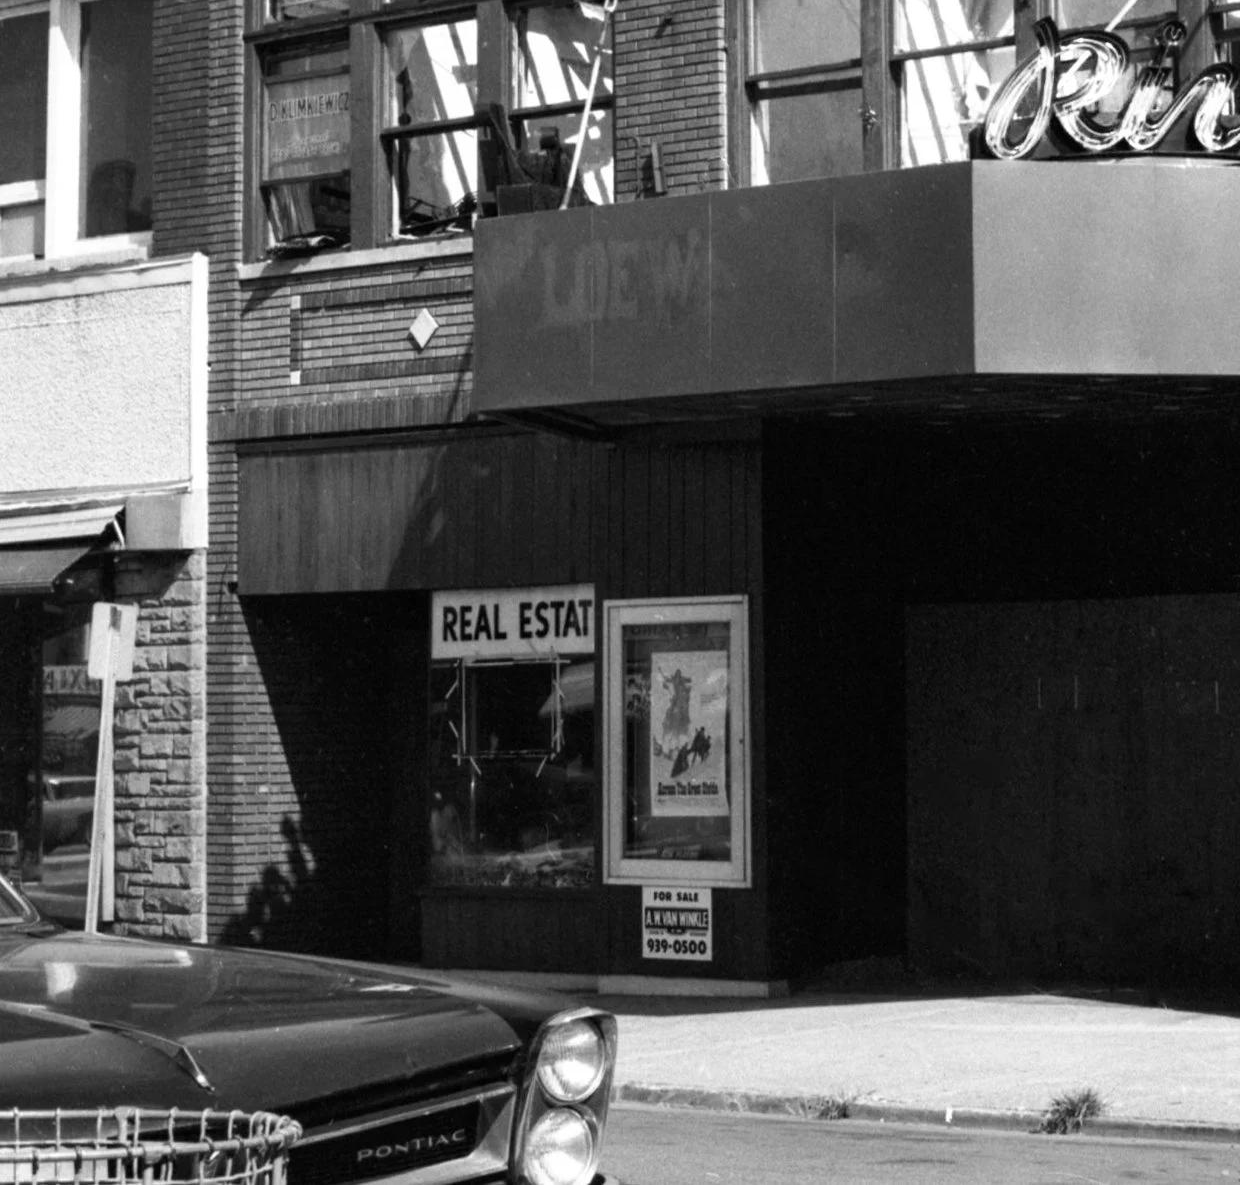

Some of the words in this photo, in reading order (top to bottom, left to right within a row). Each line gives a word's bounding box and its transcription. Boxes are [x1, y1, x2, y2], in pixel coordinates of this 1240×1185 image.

[442, 604, 507, 641] REAL
[519, 599, 593, 639] ESTAT
[653, 891, 672, 902] FOR
[676, 891, 699, 902] SALE
[647, 938, 707, 955] 939-0500
[357, 1129, 466, 1162] PONTIAC
